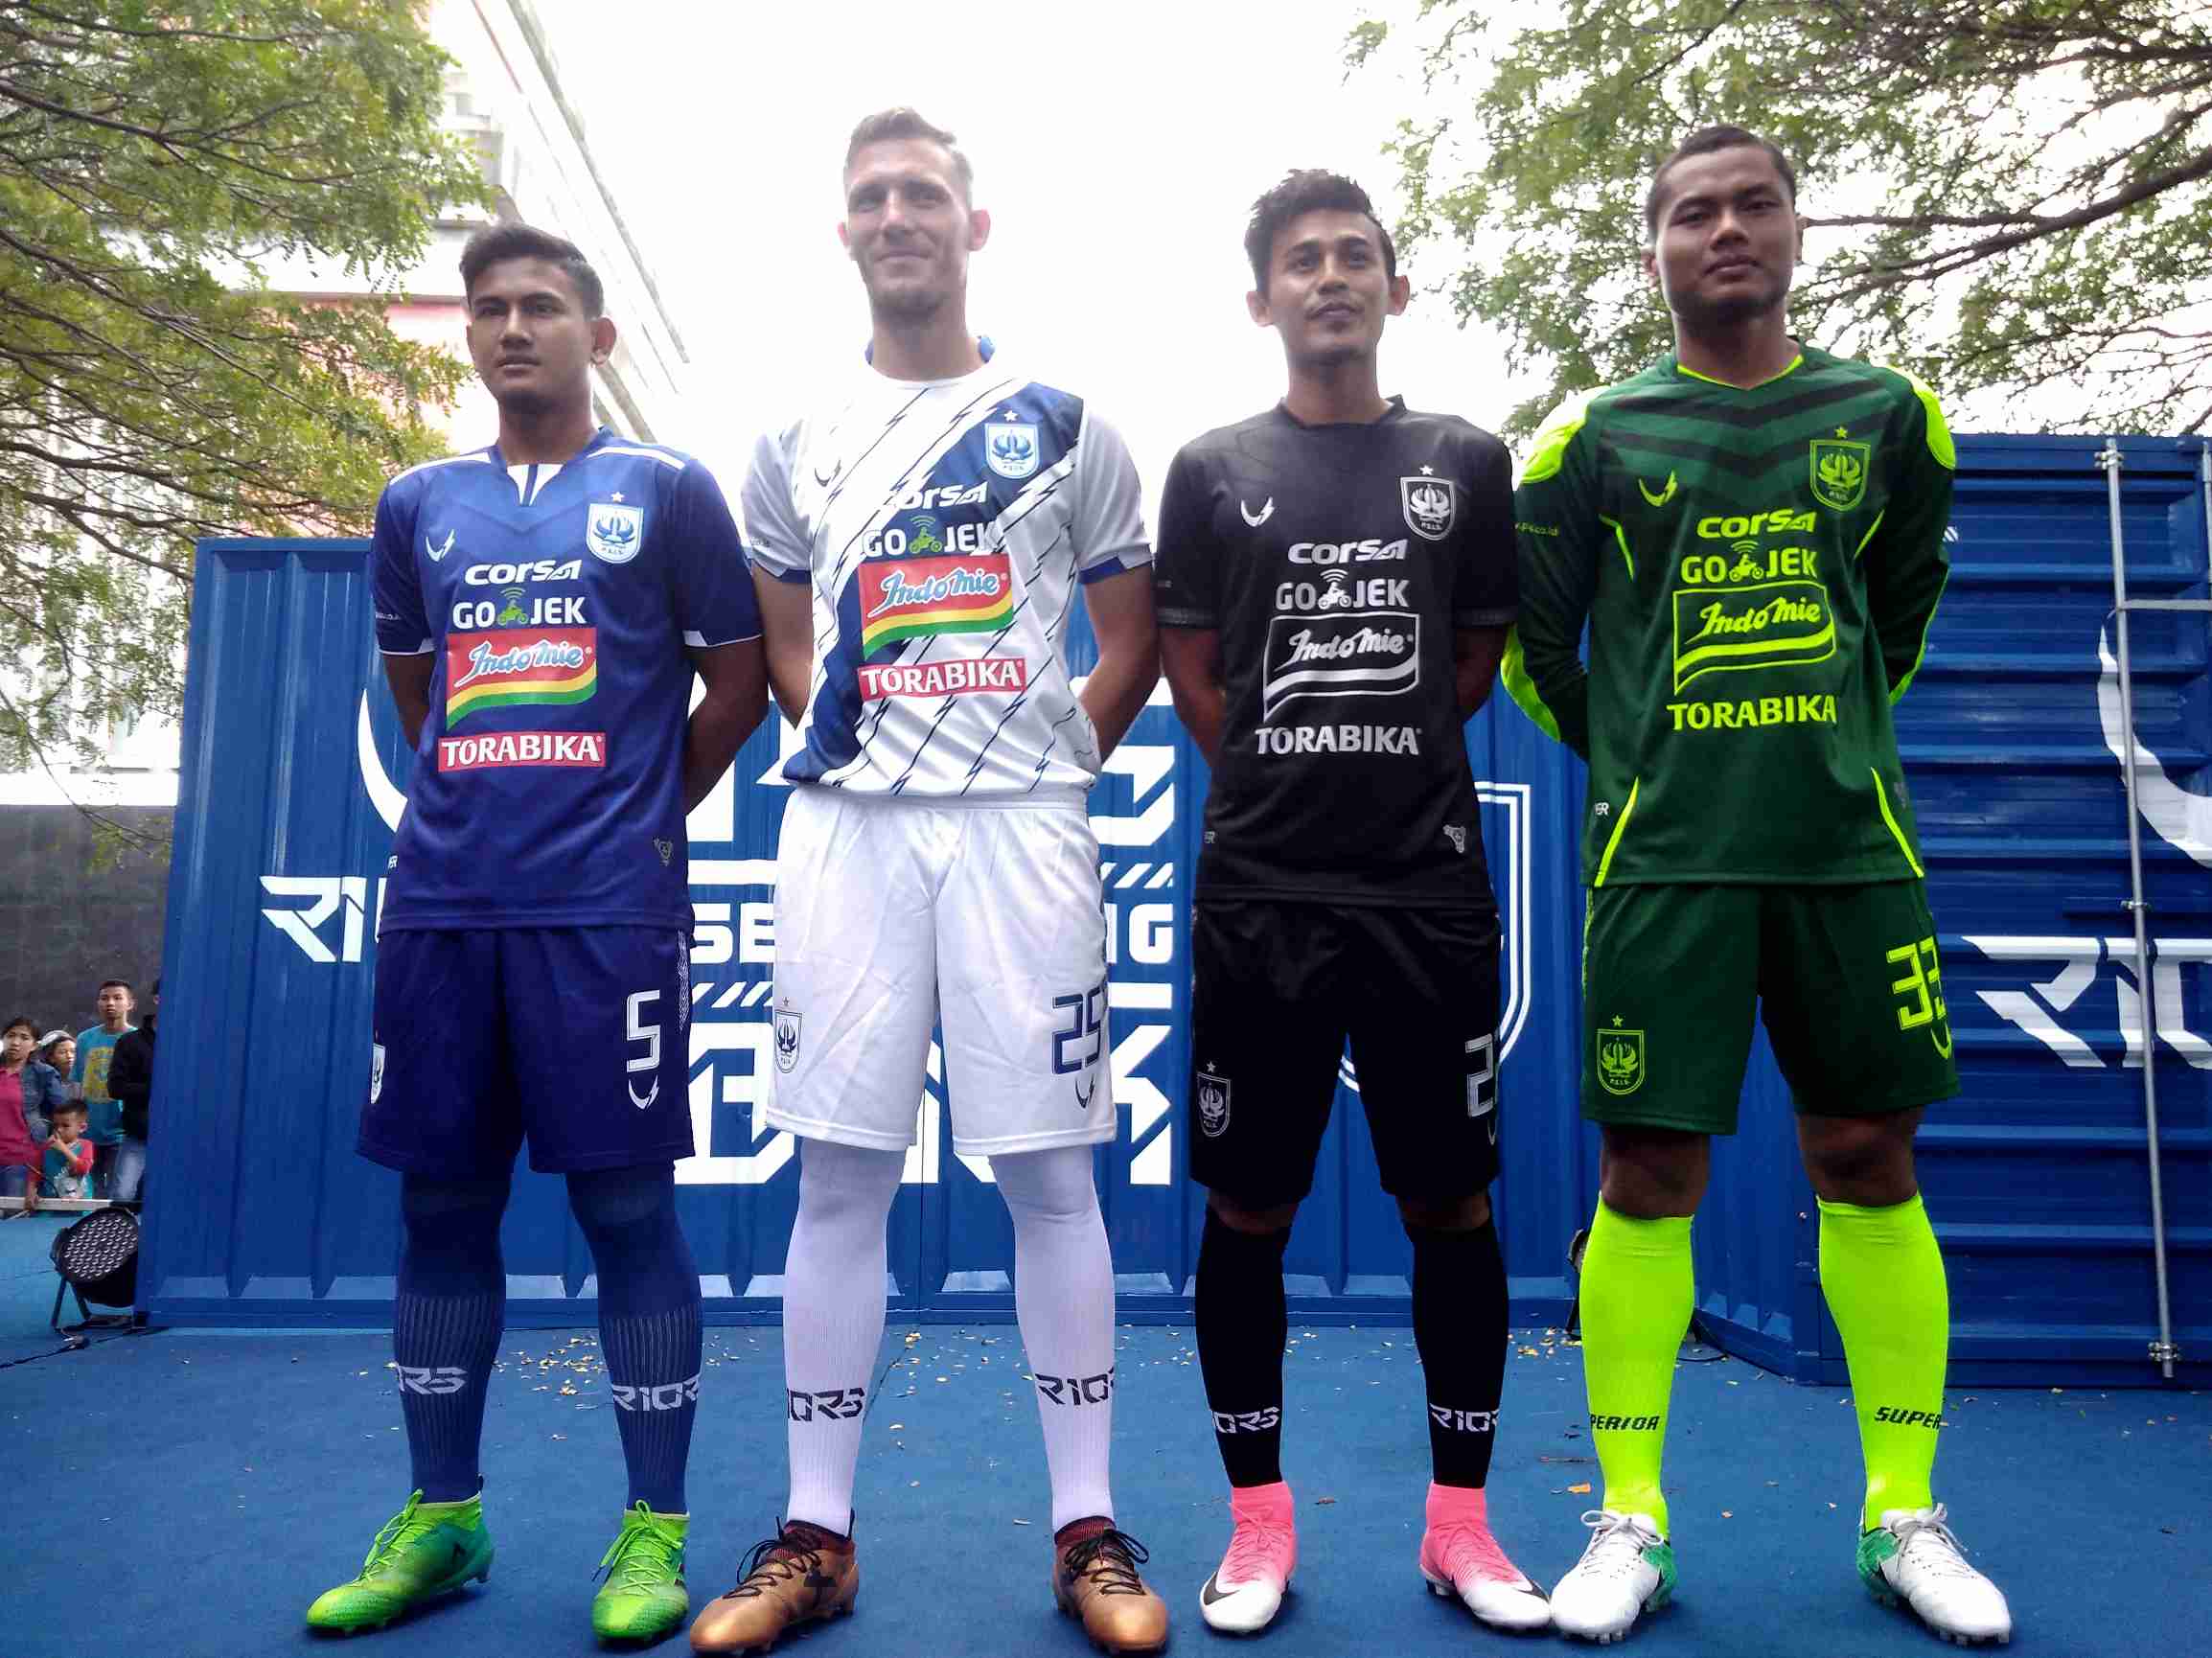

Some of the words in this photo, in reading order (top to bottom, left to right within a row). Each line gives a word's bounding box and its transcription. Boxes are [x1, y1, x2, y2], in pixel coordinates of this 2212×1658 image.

[864, 528, 907, 558] GO
[1681, 555, 1725, 584] GO
[1766, 547, 1818, 578] JEK
[1276, 582, 1316, 610] GO
[1351, 578, 1410, 608] JEK
[452, 601, 496, 629] GO
[530, 596, 587, 626] JEK
[862, 660, 1023, 696] TORABIKA
[1667, 695, 1837, 730] TORABIKA
[442, 736, 601, 768] TORABIKA
[1255, 725, 1419, 756] TORABIKA
[627, 989, 661, 1073] 5
[1465, 1033, 1496, 1117] 2
